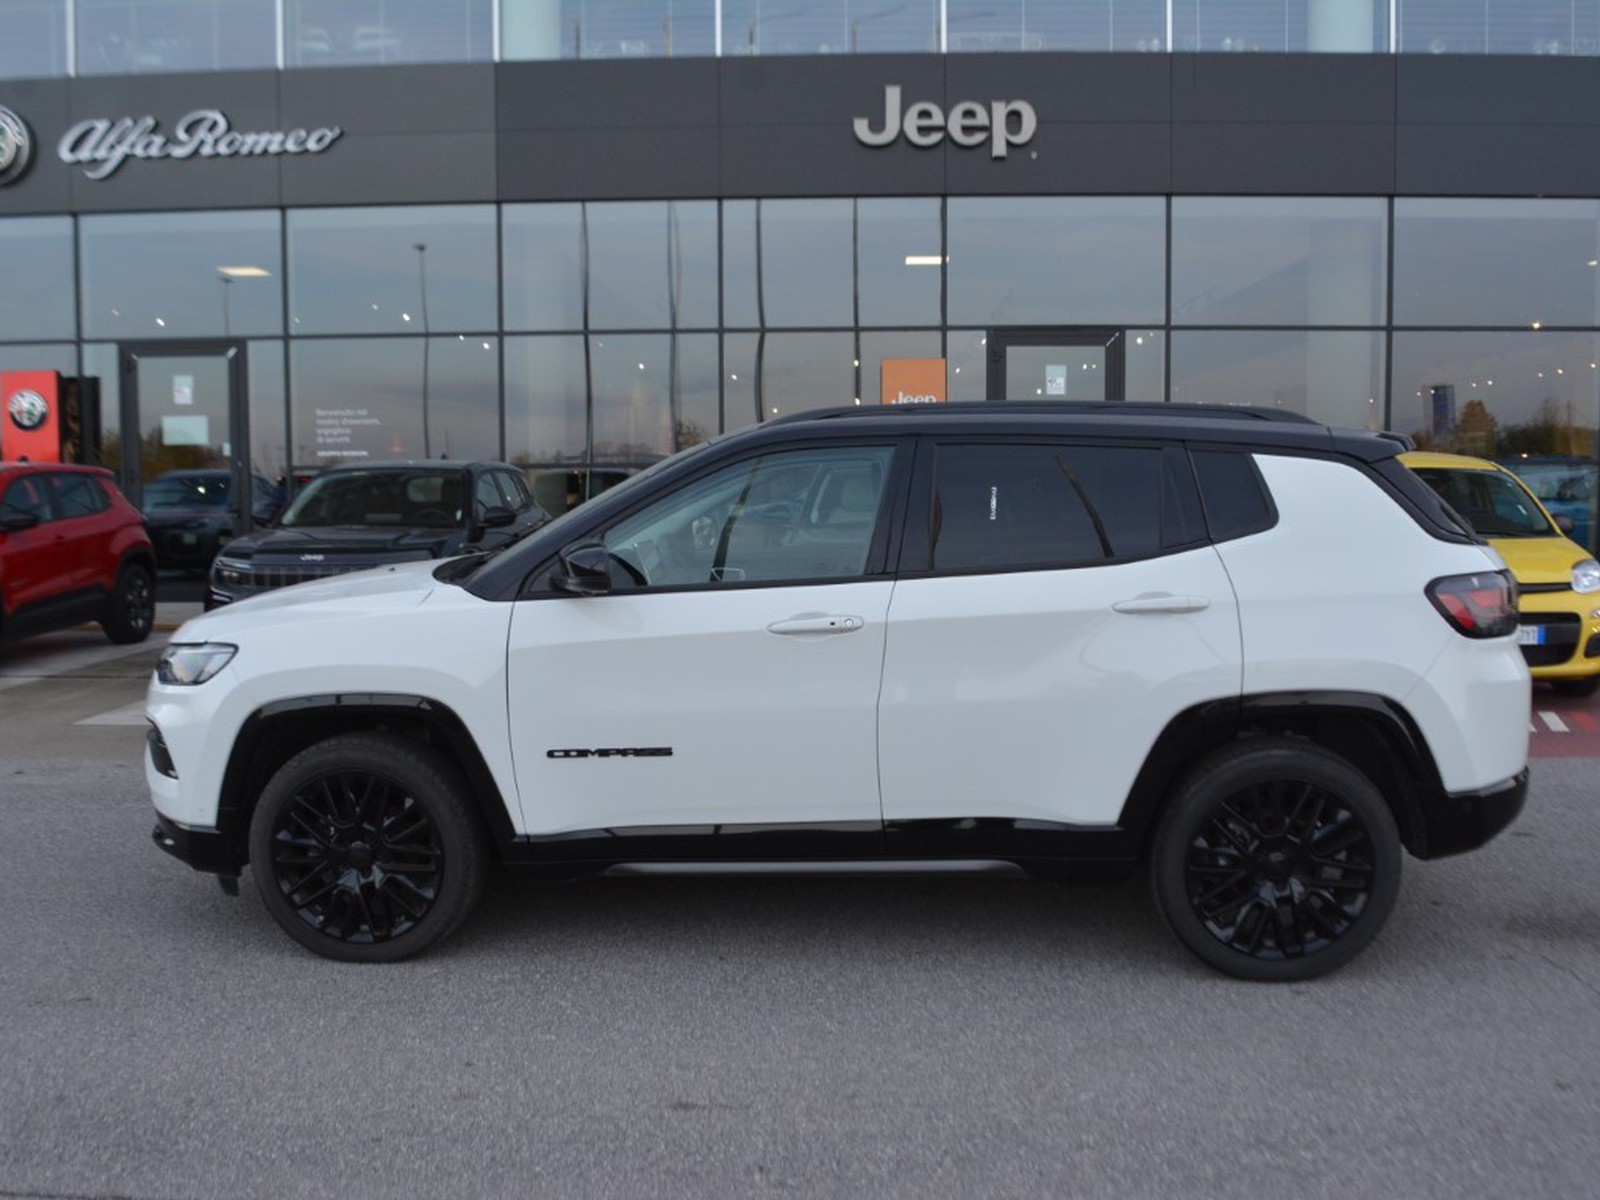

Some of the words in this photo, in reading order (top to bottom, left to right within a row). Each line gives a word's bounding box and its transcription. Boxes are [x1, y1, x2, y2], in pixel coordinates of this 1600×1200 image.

[58, 115, 169, 179] Alfa
[170, 109, 342, 158] Romeo
[853, 84, 1037, 158] Jeep
